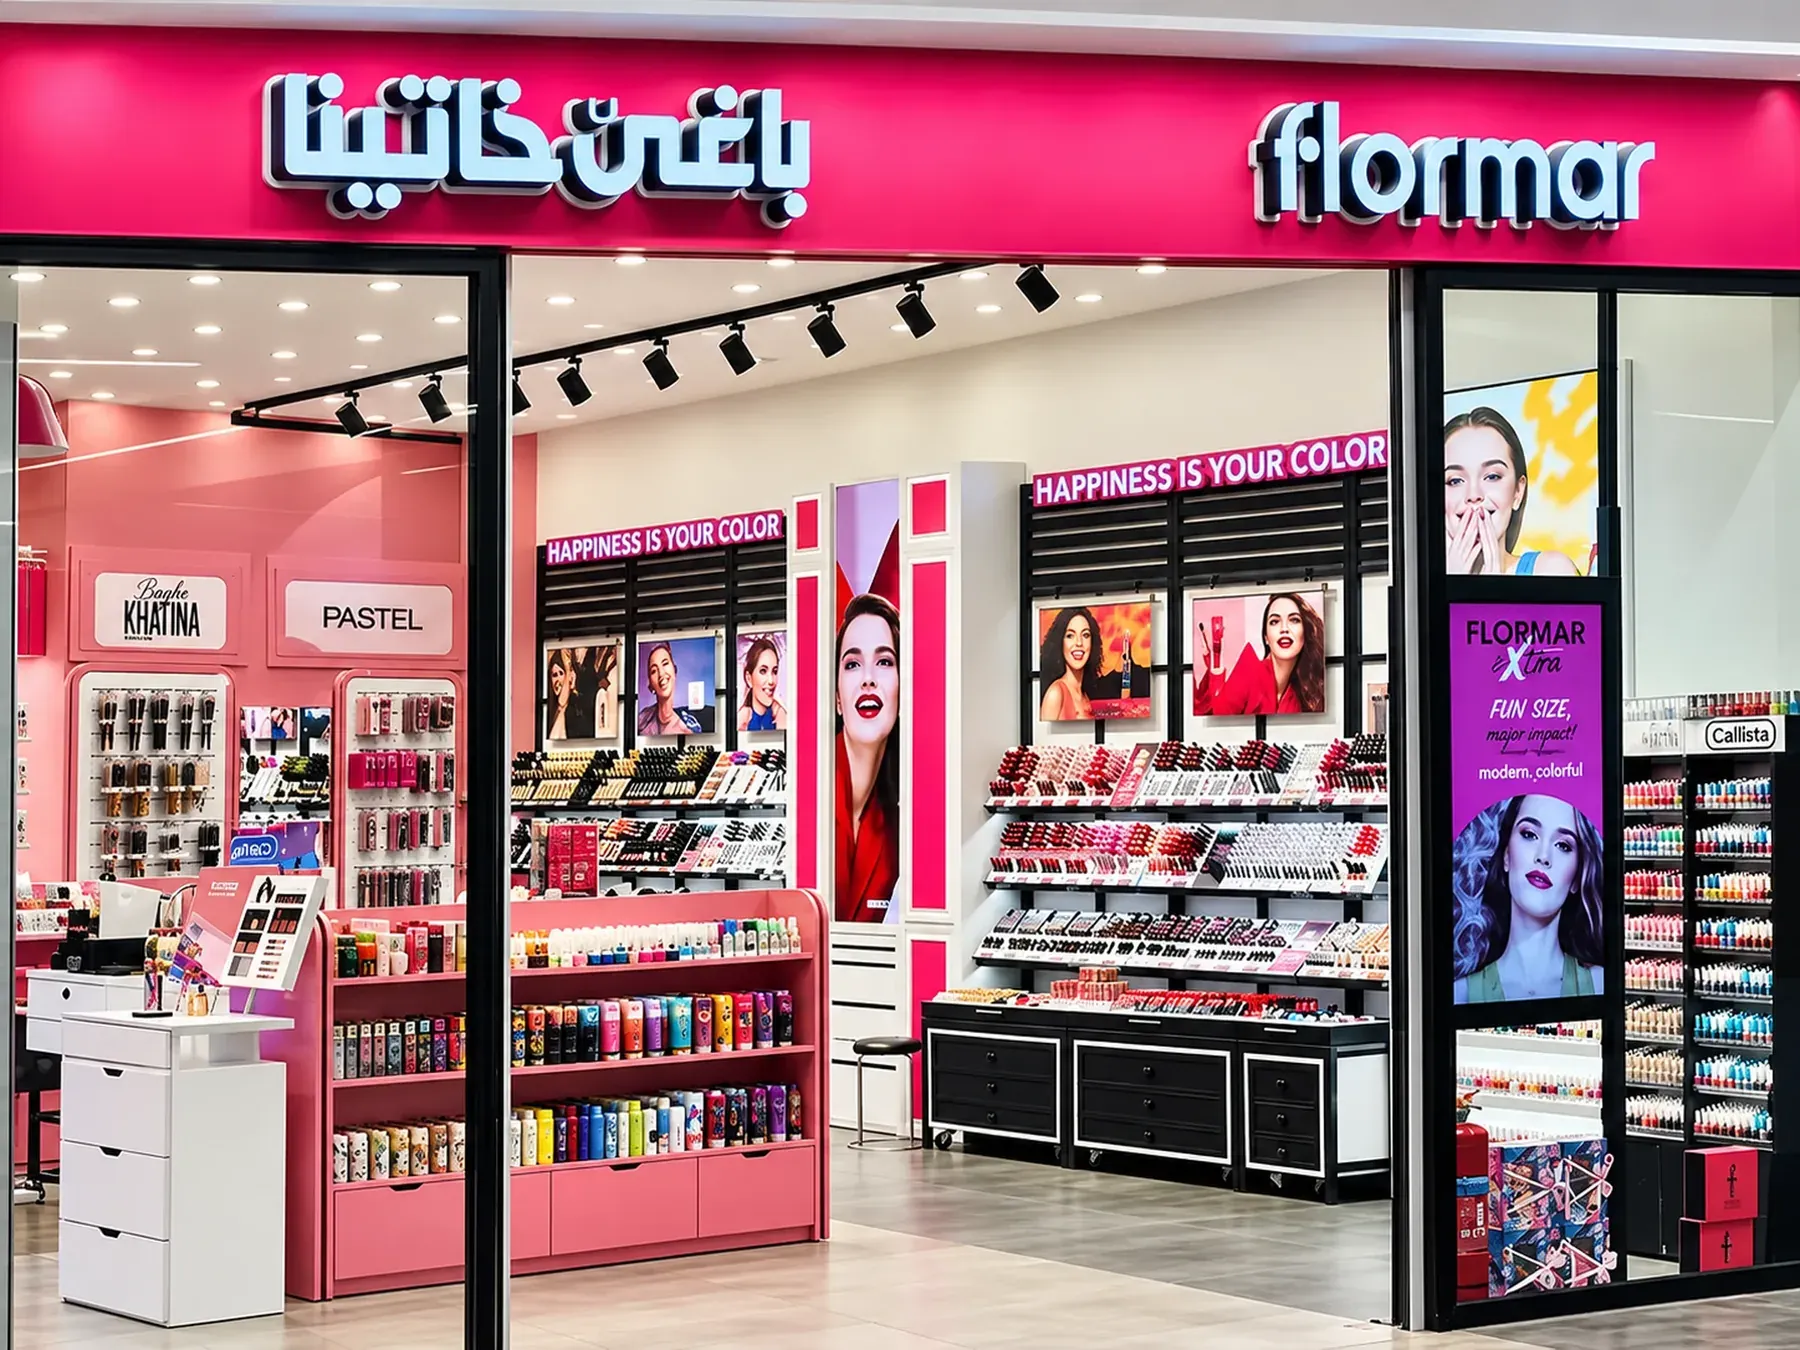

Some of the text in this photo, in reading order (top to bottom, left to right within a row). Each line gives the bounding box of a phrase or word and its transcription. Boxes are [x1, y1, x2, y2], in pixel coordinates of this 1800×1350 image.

[1260, 100, 1656, 225] flormar
[1036, 435, 1387, 505] HAPPINESS IS YOUR COLOR
[547, 513, 781, 564] HAPPINESS IS YOUR COLOR
[133, 577, 189, 609] Baghe
[123, 599, 201, 637] KHATINA
[322, 605, 424, 632] PASTEL
[1466, 620, 1586, 645] FLORMAR
[1489, 698, 1572, 721] FUN SIZE,
[1486, 724, 1579, 756] major impact!
[1712, 725, 1770, 744] Callista
[1535, 761, 1583, 778] colorful
